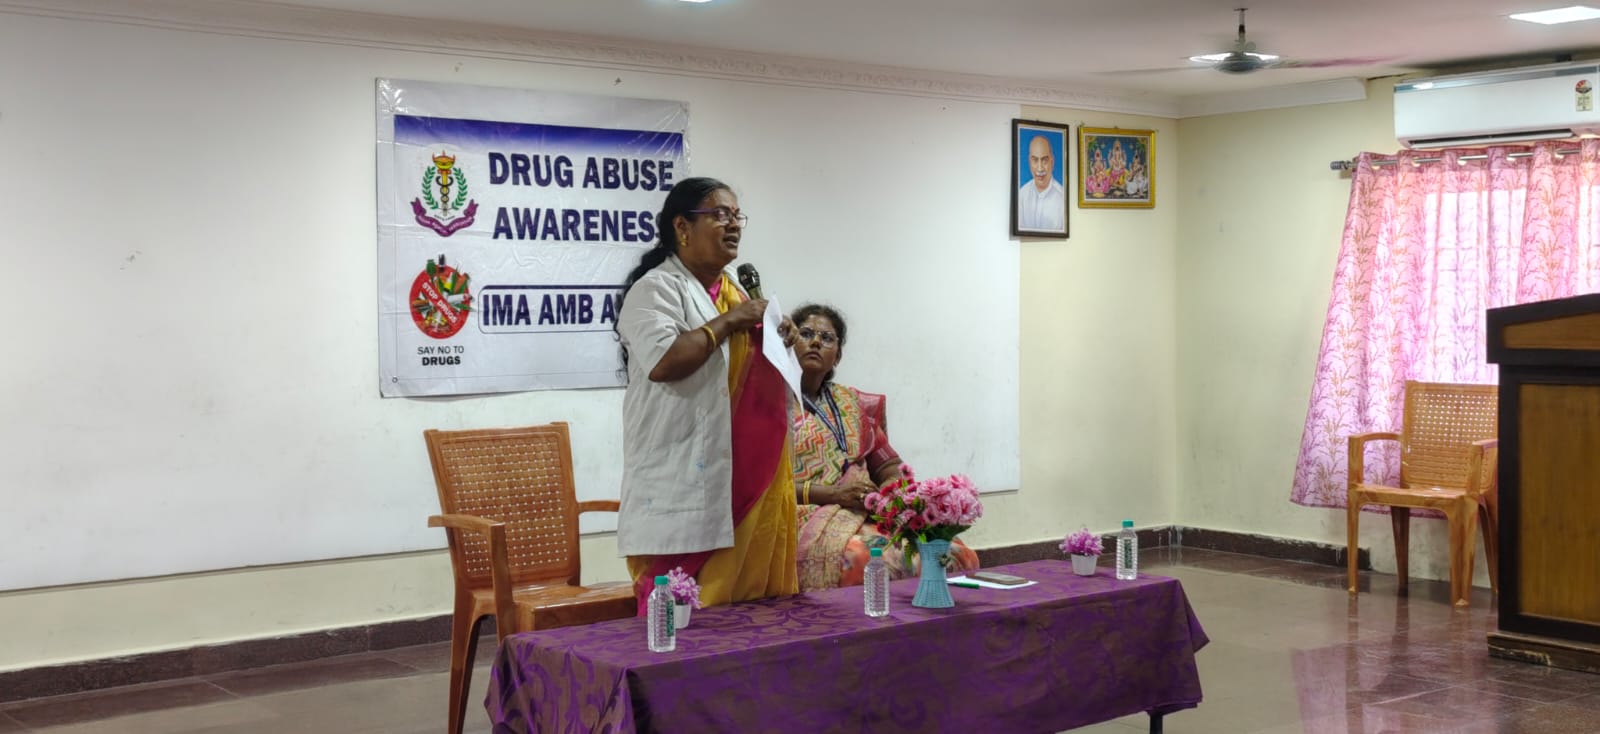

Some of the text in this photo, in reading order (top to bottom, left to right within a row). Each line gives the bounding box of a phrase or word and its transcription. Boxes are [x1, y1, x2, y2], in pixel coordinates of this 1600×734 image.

[488, 152, 674, 192] DRUG ABUSE
[492, 206, 660, 243] AWARENES
[422, 282, 458, 323] STOP DRUGS
[482, 294, 532, 326] IMA
[538, 293, 593, 325] AMB
[417, 345, 465, 355] SAY NO TO
[422, 356, 461, 367] DRUGS
